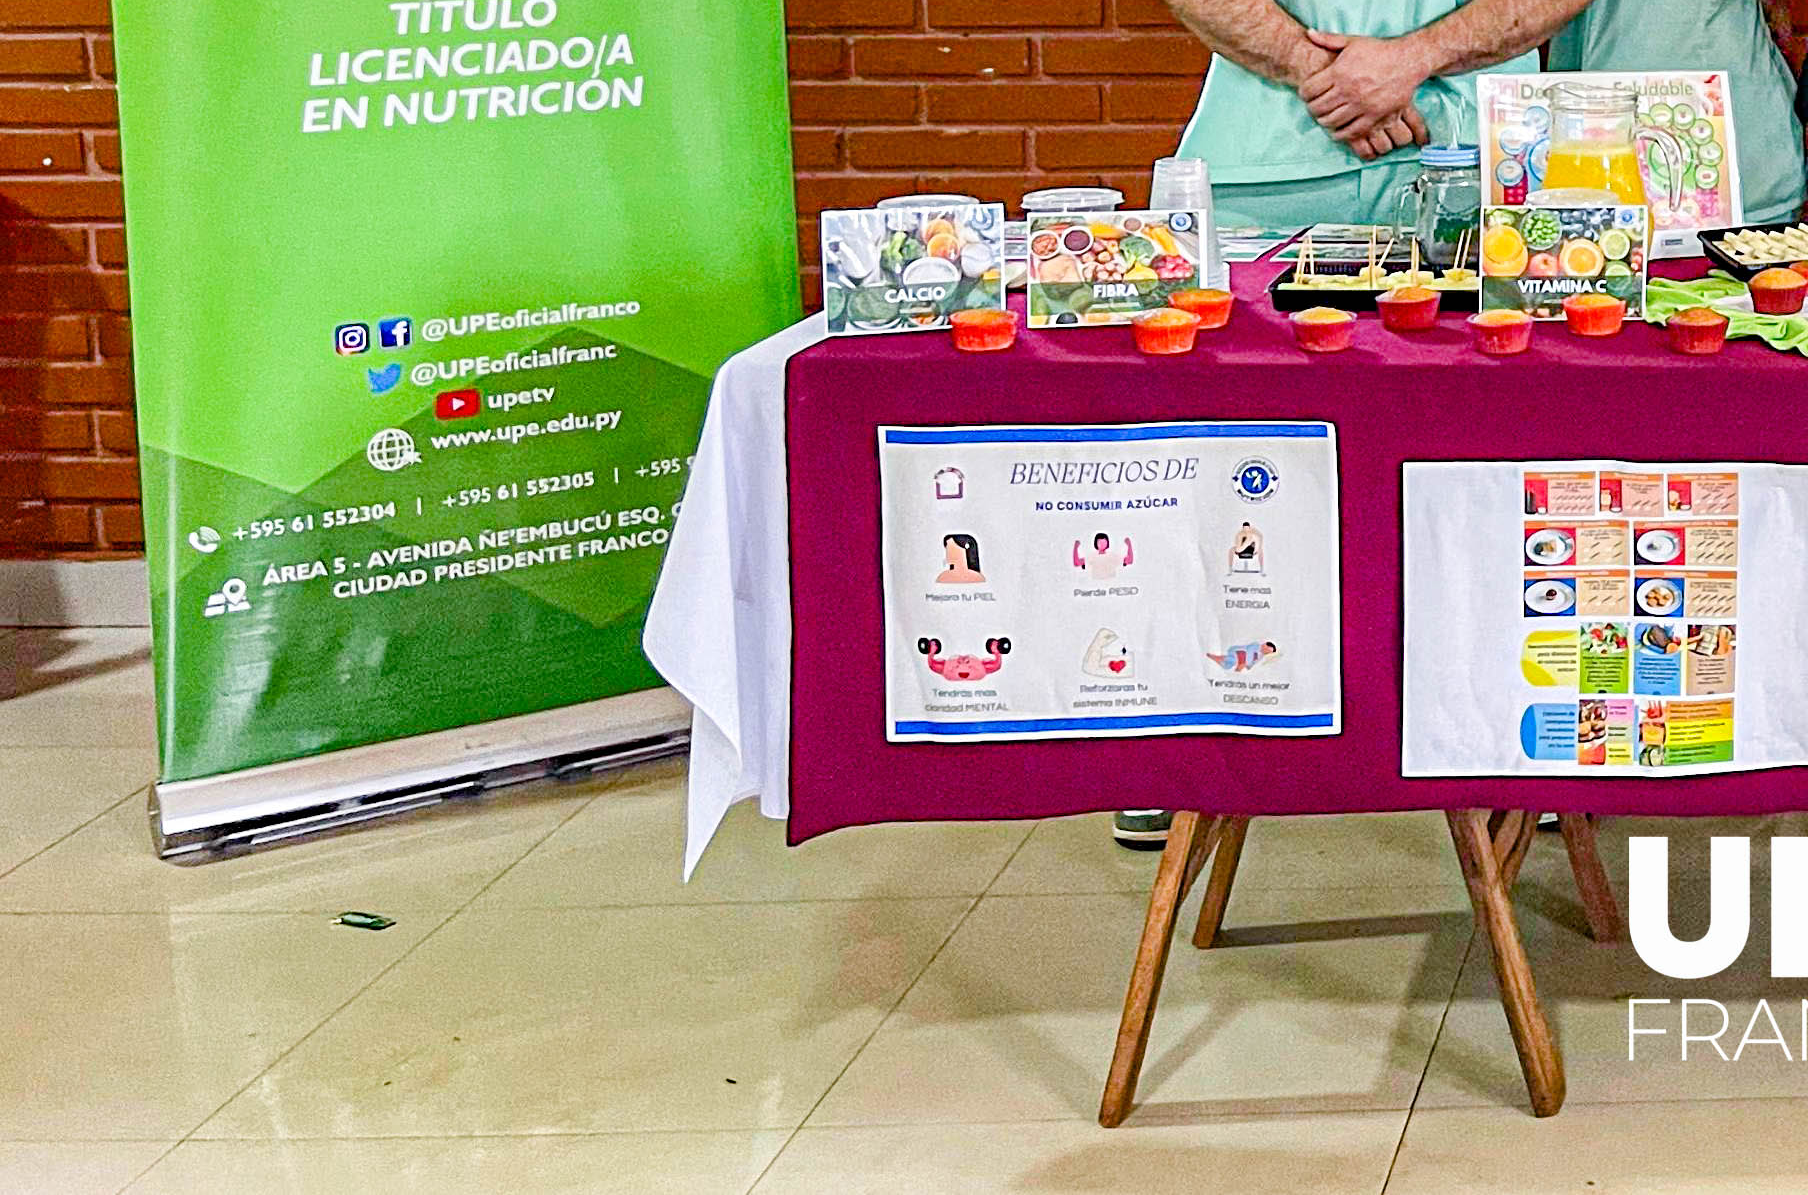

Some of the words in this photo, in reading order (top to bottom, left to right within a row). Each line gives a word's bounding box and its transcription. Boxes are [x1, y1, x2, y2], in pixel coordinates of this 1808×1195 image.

[310, 34, 635, 86] LICENCIADO/A
[302, 95, 370, 133] EN
[384, 75, 643, 127] NUTRICIÓN
[884, 287, 946, 303] CALCIO
[1093, 283, 1139, 298] FIBRA
[1518, 279, 1594, 293] VITAMINA
[1596, 280, 1608, 293] C
[422, 300, 641, 342] @UPEoficialfranco
[411, 344, 617, 386] @UPEoficialfranc
[488, 387, 556, 411] upetv
[431, 410, 622, 450] www.upe.edu.py
[1010, 460, 1160, 485] BENEFICIOS
[1163, 457, 1200, 480] DE
[232, 518, 286, 541] +595
[292, 514, 315, 533] 61
[323, 501, 396, 528] 552304
[442, 488, 492, 508] +595
[497, 483, 518, 500] 61
[527, 471, 595, 496] 552305
[635, 458, 682, 478] +595
[1035, 501, 1053, 511] NO
[1057, 500, 1123, 511] CONSUMIR
[1127, 497, 1178, 509] AZÚCAR
[263, 560, 329, 587] ÁREA
[334, 556, 346, 575] 5
[367, 537, 473, 569] AVENIDA
[618, 506, 666, 527] ESQ.
[333, 568, 427, 598] CIUDAD
[434, 544, 572, 582] PRESIDENTE
[578, 528, 670, 558] FRANCO
[1109, 586, 1139, 596] PESO
[965, 702, 1008, 711] MENTAL
